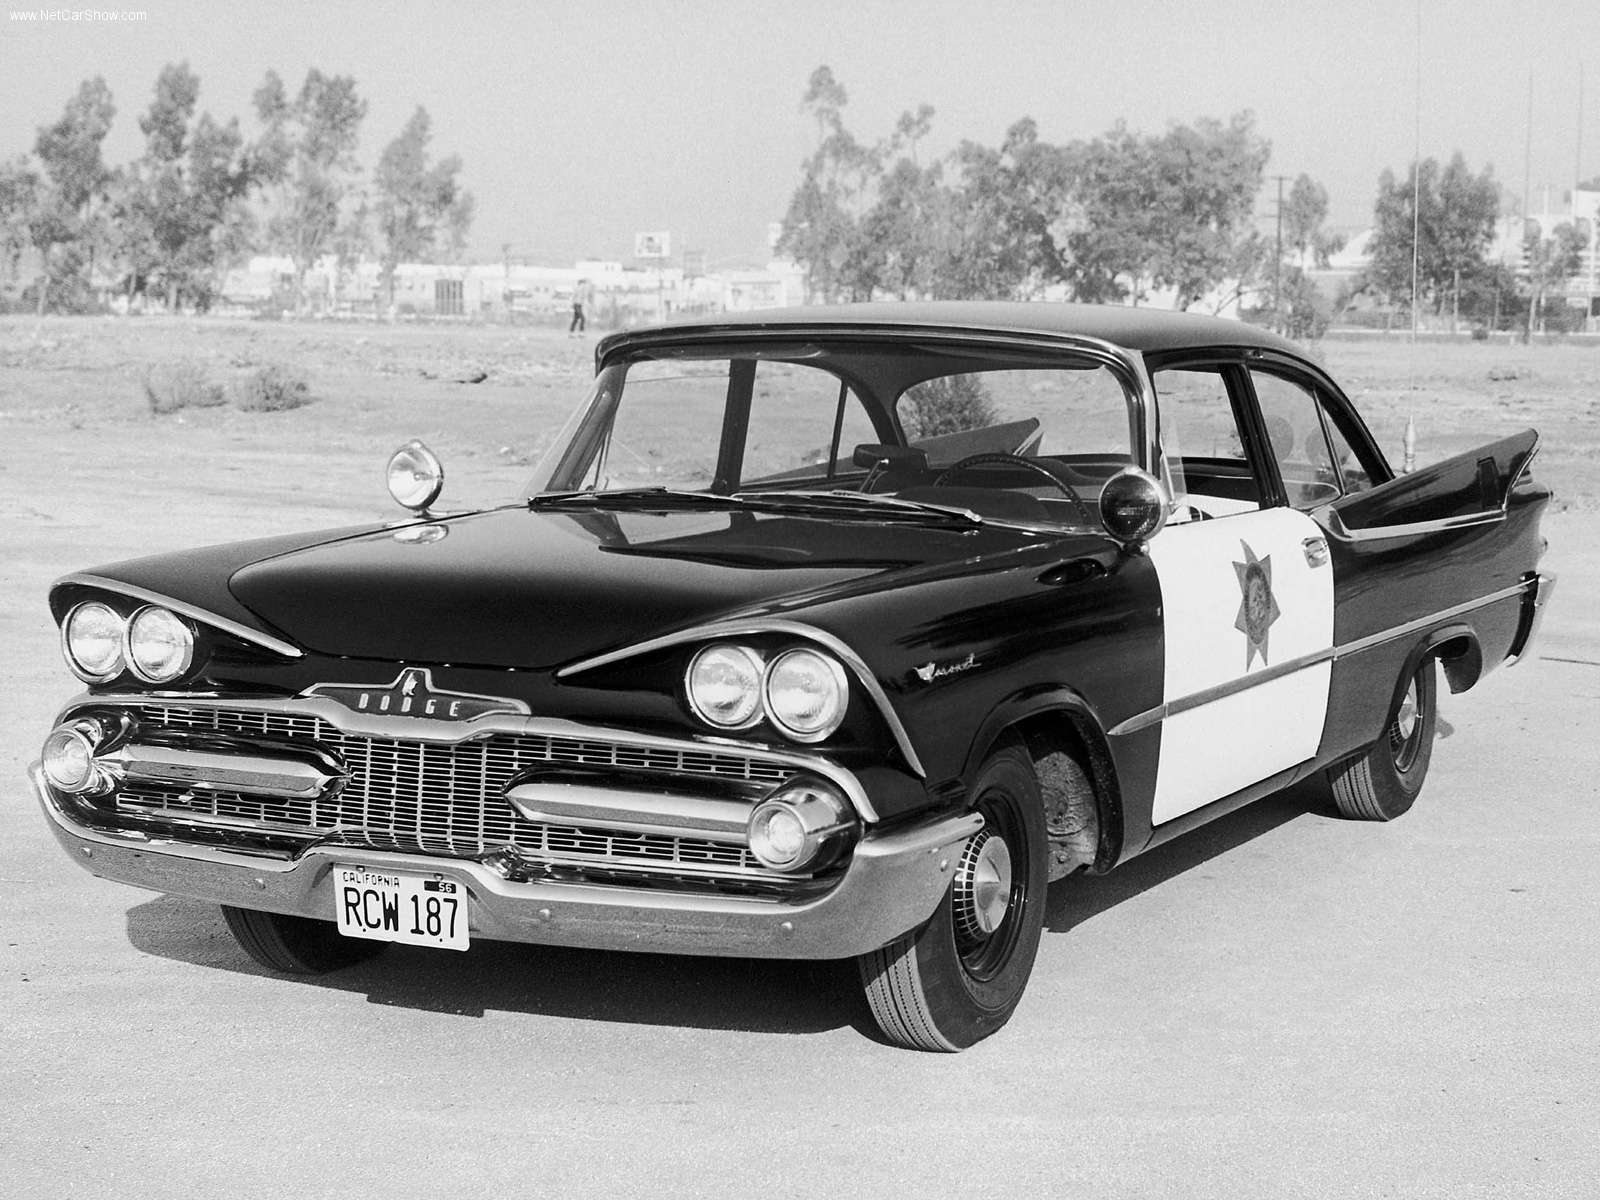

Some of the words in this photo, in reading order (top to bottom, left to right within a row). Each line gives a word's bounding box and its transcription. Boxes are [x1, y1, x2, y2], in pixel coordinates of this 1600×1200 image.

[358, 693, 461, 717] DODGE
[342, 871, 400, 887] CALIFORNIA
[343, 886, 400, 933] RCW
[410, 894, 458, 939] 187
